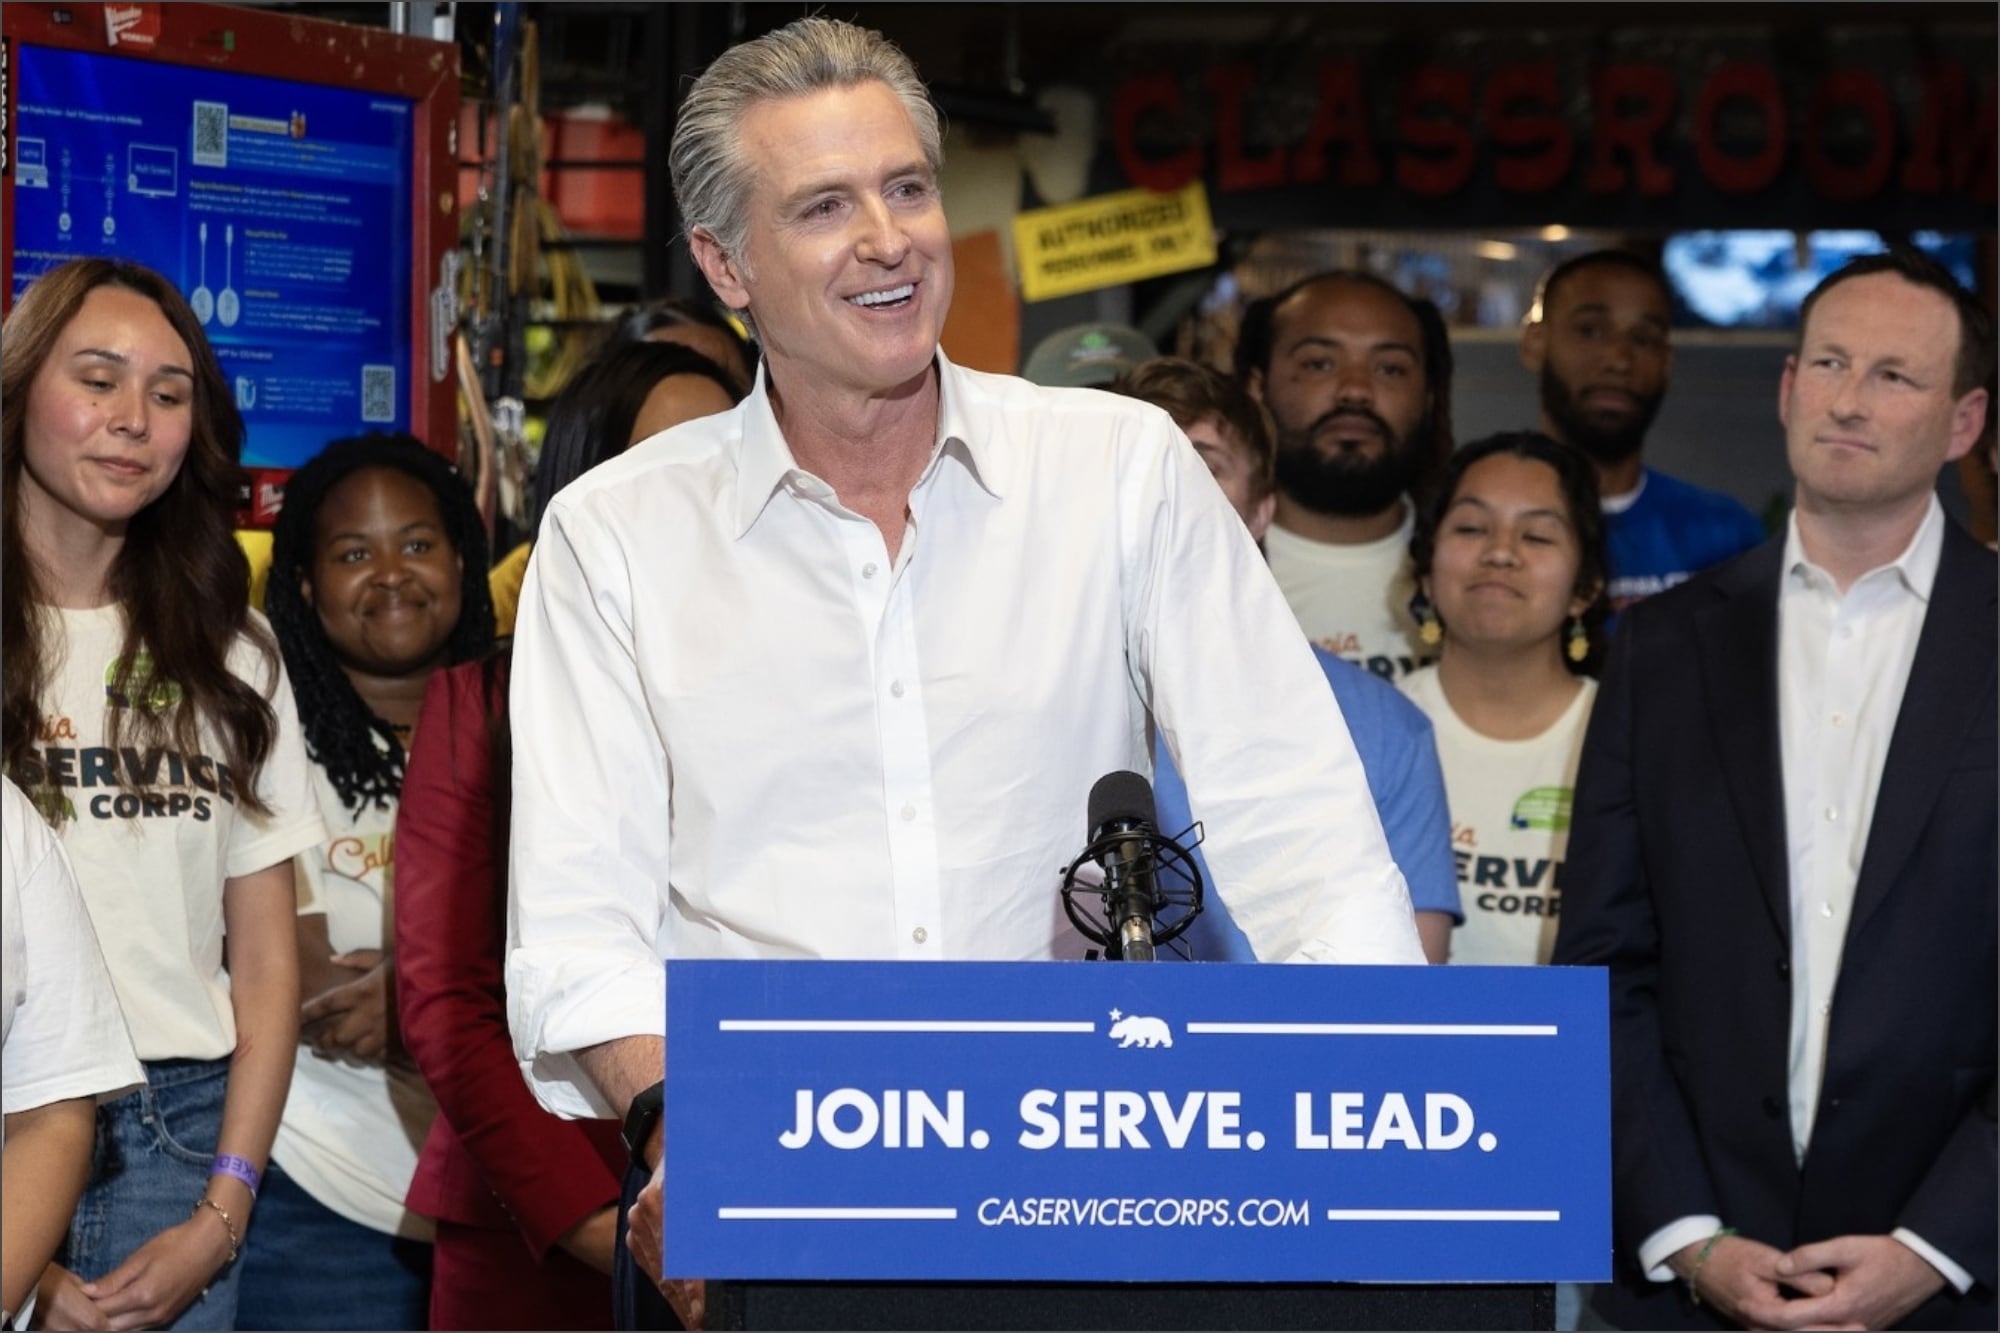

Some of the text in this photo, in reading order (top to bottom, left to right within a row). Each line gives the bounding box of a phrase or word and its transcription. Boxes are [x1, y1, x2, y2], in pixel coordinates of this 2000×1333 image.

[1112, 60, 1997, 201] CLASSROOM
[1038, 197, 1184, 249] AUTHORIZED
[89, 792, 212, 822] CORPS
[778, 1088, 1497, 1152] JOIN. SERVE. LEAD.
[977, 1198, 1310, 1227] CASERVICECORPS.COM
